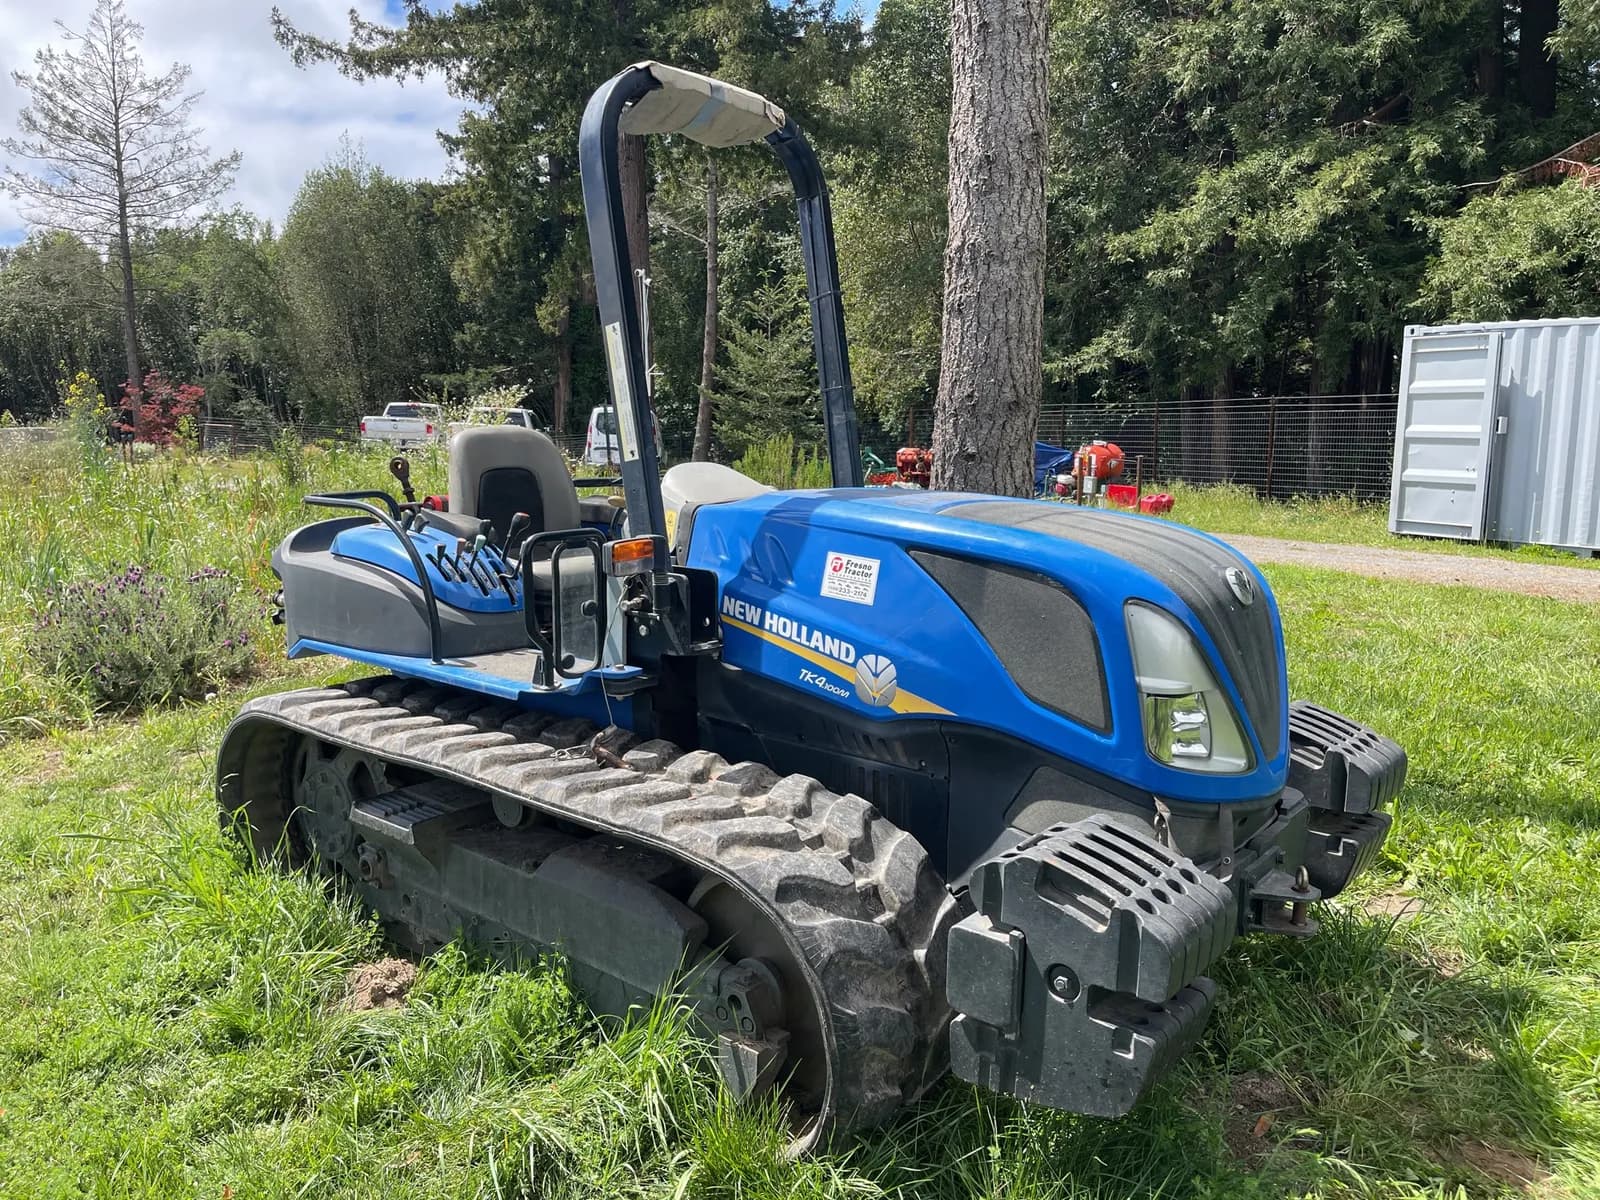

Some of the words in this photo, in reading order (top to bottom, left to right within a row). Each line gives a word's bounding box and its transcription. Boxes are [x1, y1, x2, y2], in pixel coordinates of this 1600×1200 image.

[845, 559, 873, 571] Fresno
[844, 567, 873, 579] Tractor
[722, 595, 762, 626] NEW
[764, 611, 856, 664] HOLLAND
